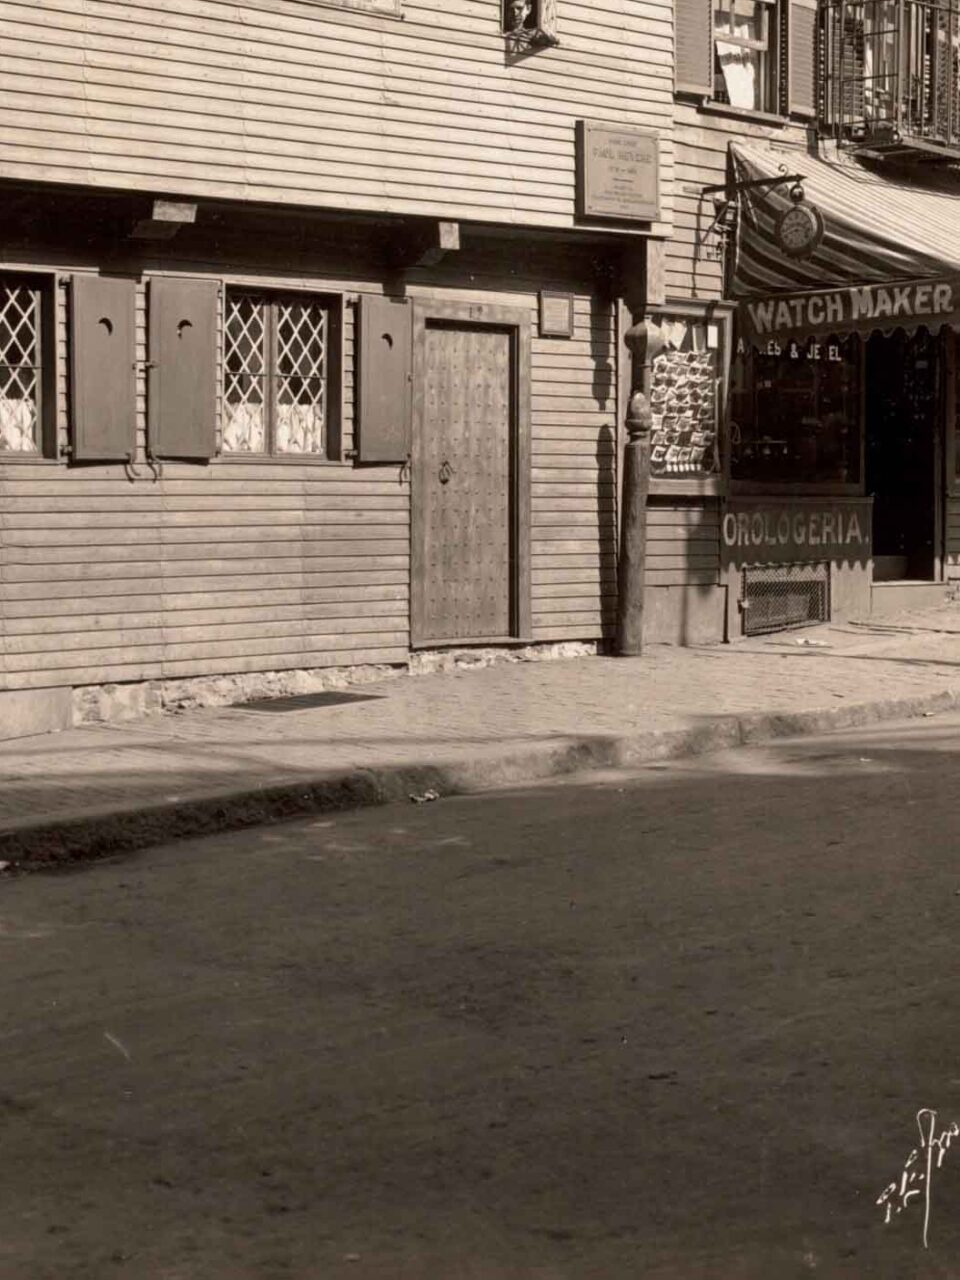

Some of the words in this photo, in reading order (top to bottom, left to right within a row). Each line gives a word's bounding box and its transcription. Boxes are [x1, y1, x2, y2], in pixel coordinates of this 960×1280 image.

[748, 293, 844, 334] WATCH
[850, 284, 954, 320] MAKER
[723, 512, 870, 546] OROLOGERIA.
